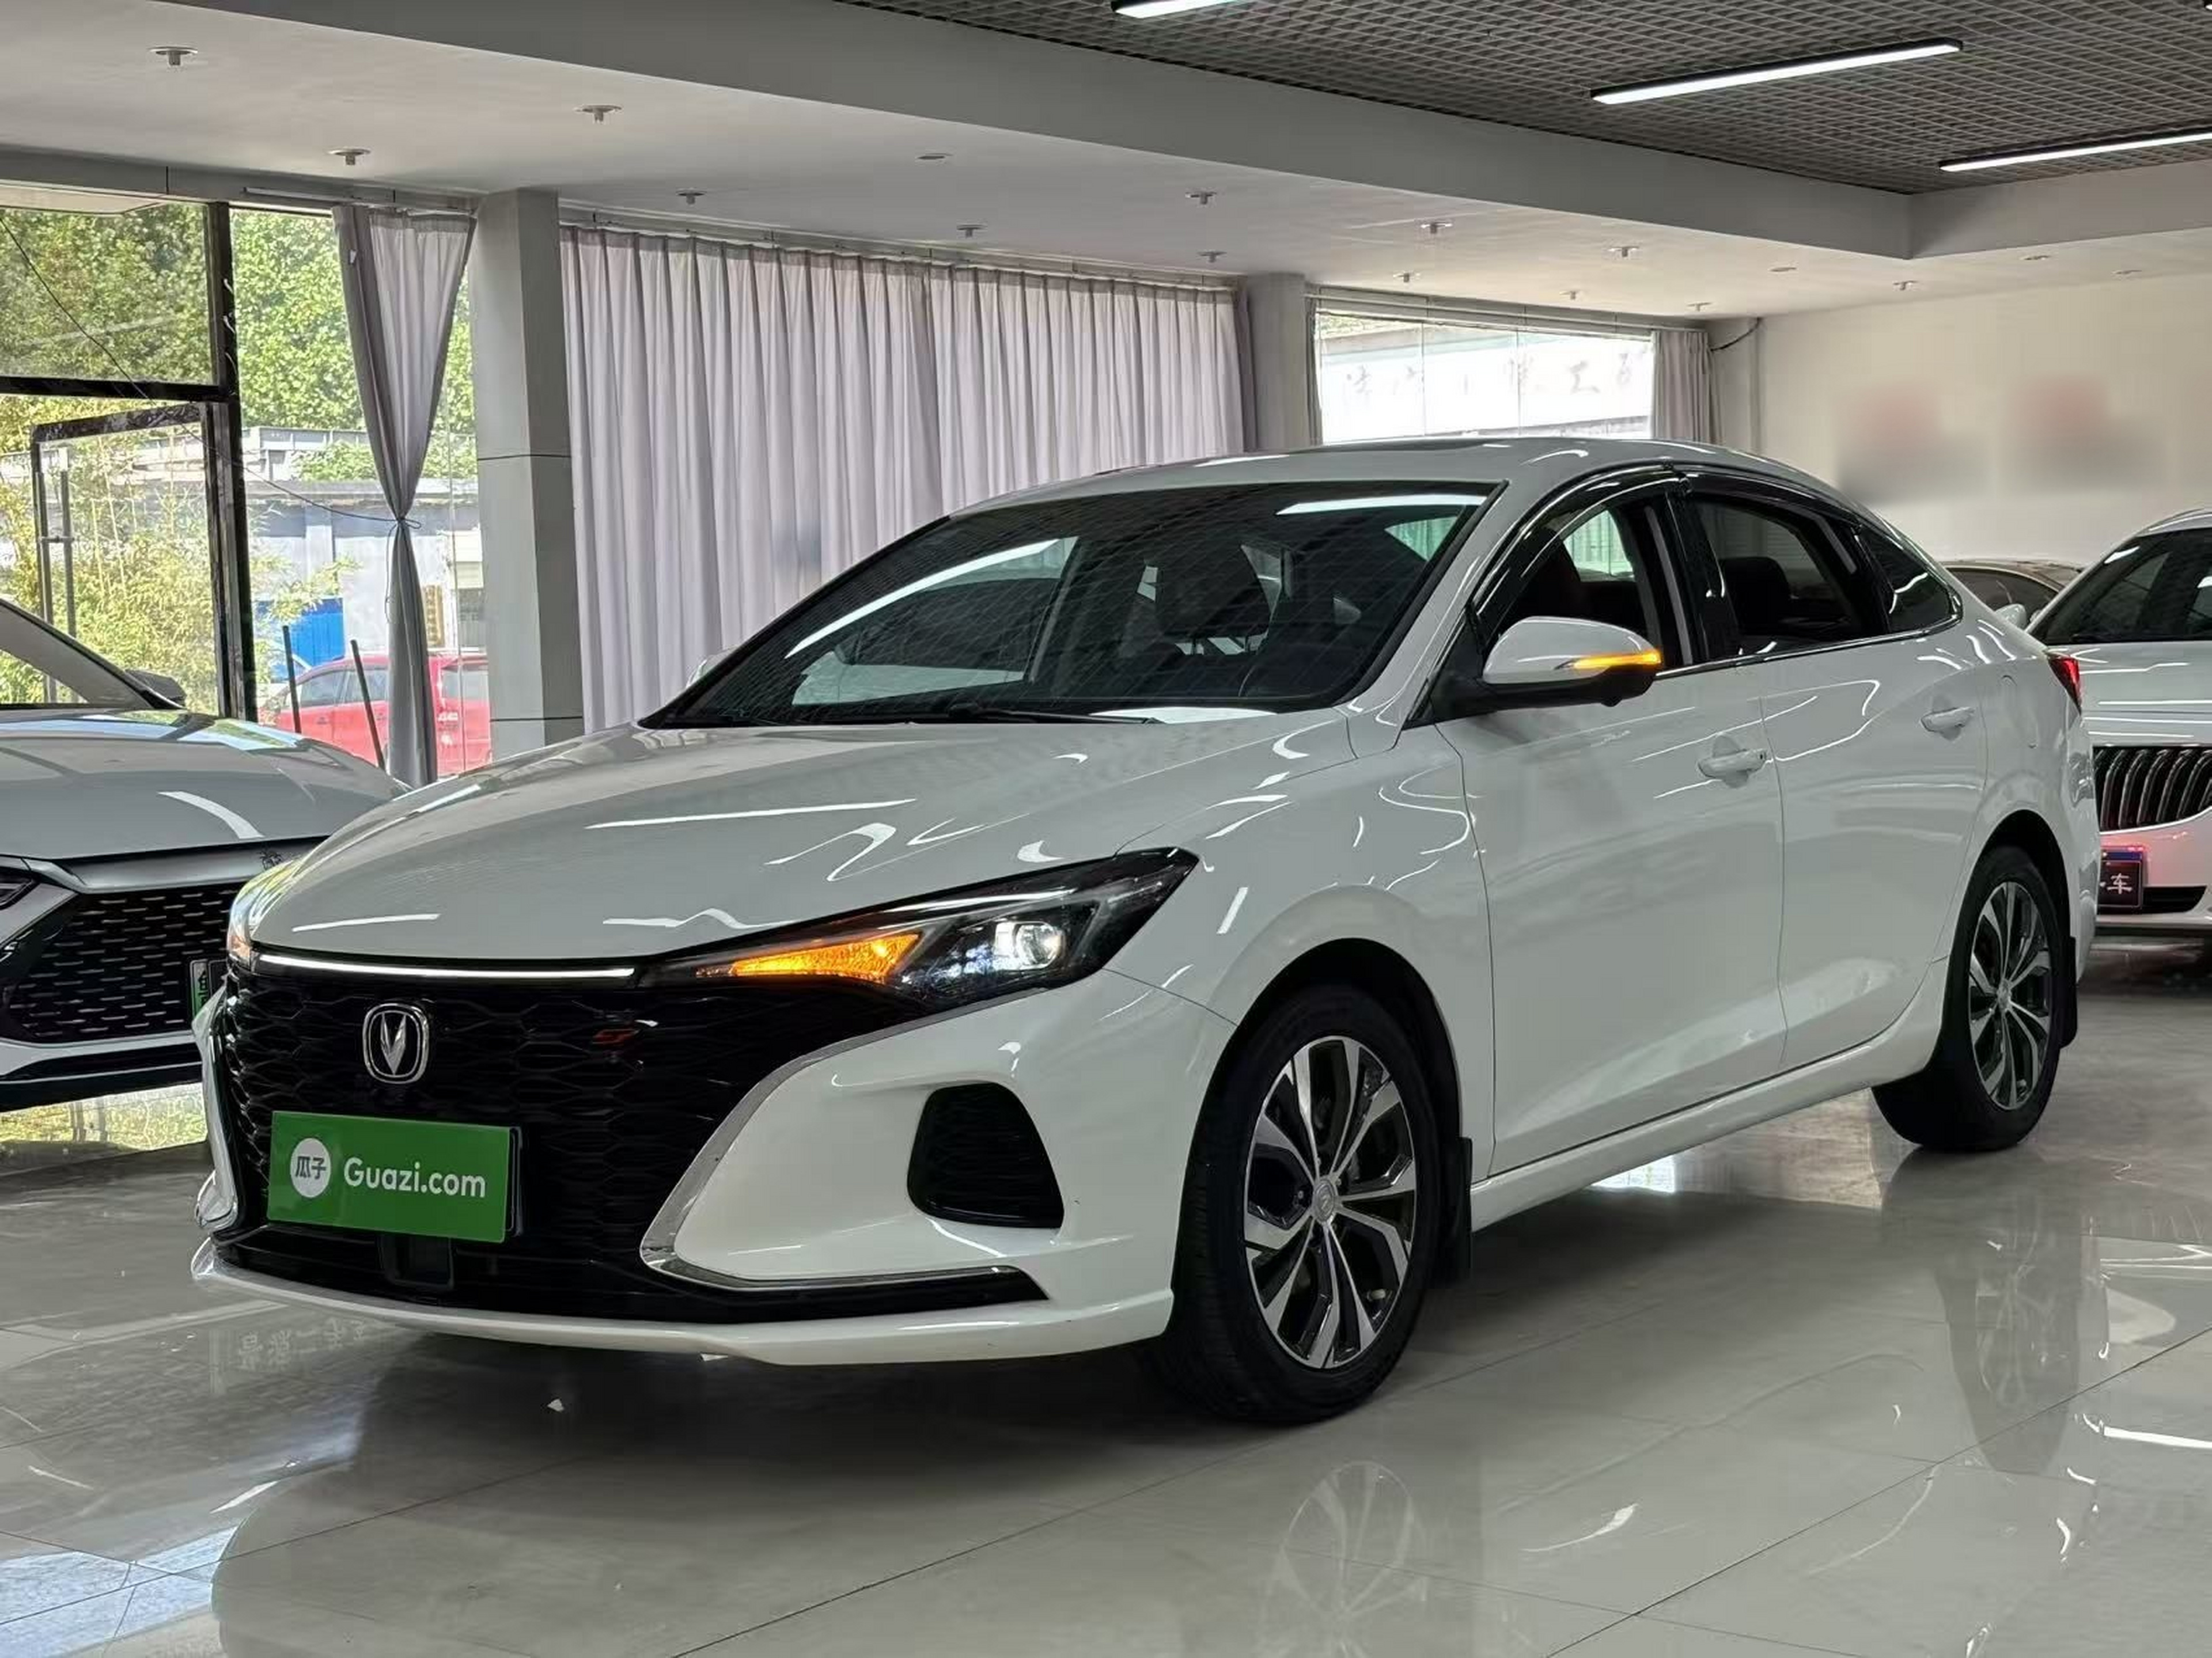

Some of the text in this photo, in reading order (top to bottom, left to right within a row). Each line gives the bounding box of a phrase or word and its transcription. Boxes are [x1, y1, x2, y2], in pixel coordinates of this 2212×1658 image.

[2100, 873, 2133, 894] 车
[296, 1156, 486, 1198] 瓜子 Guazi.com
